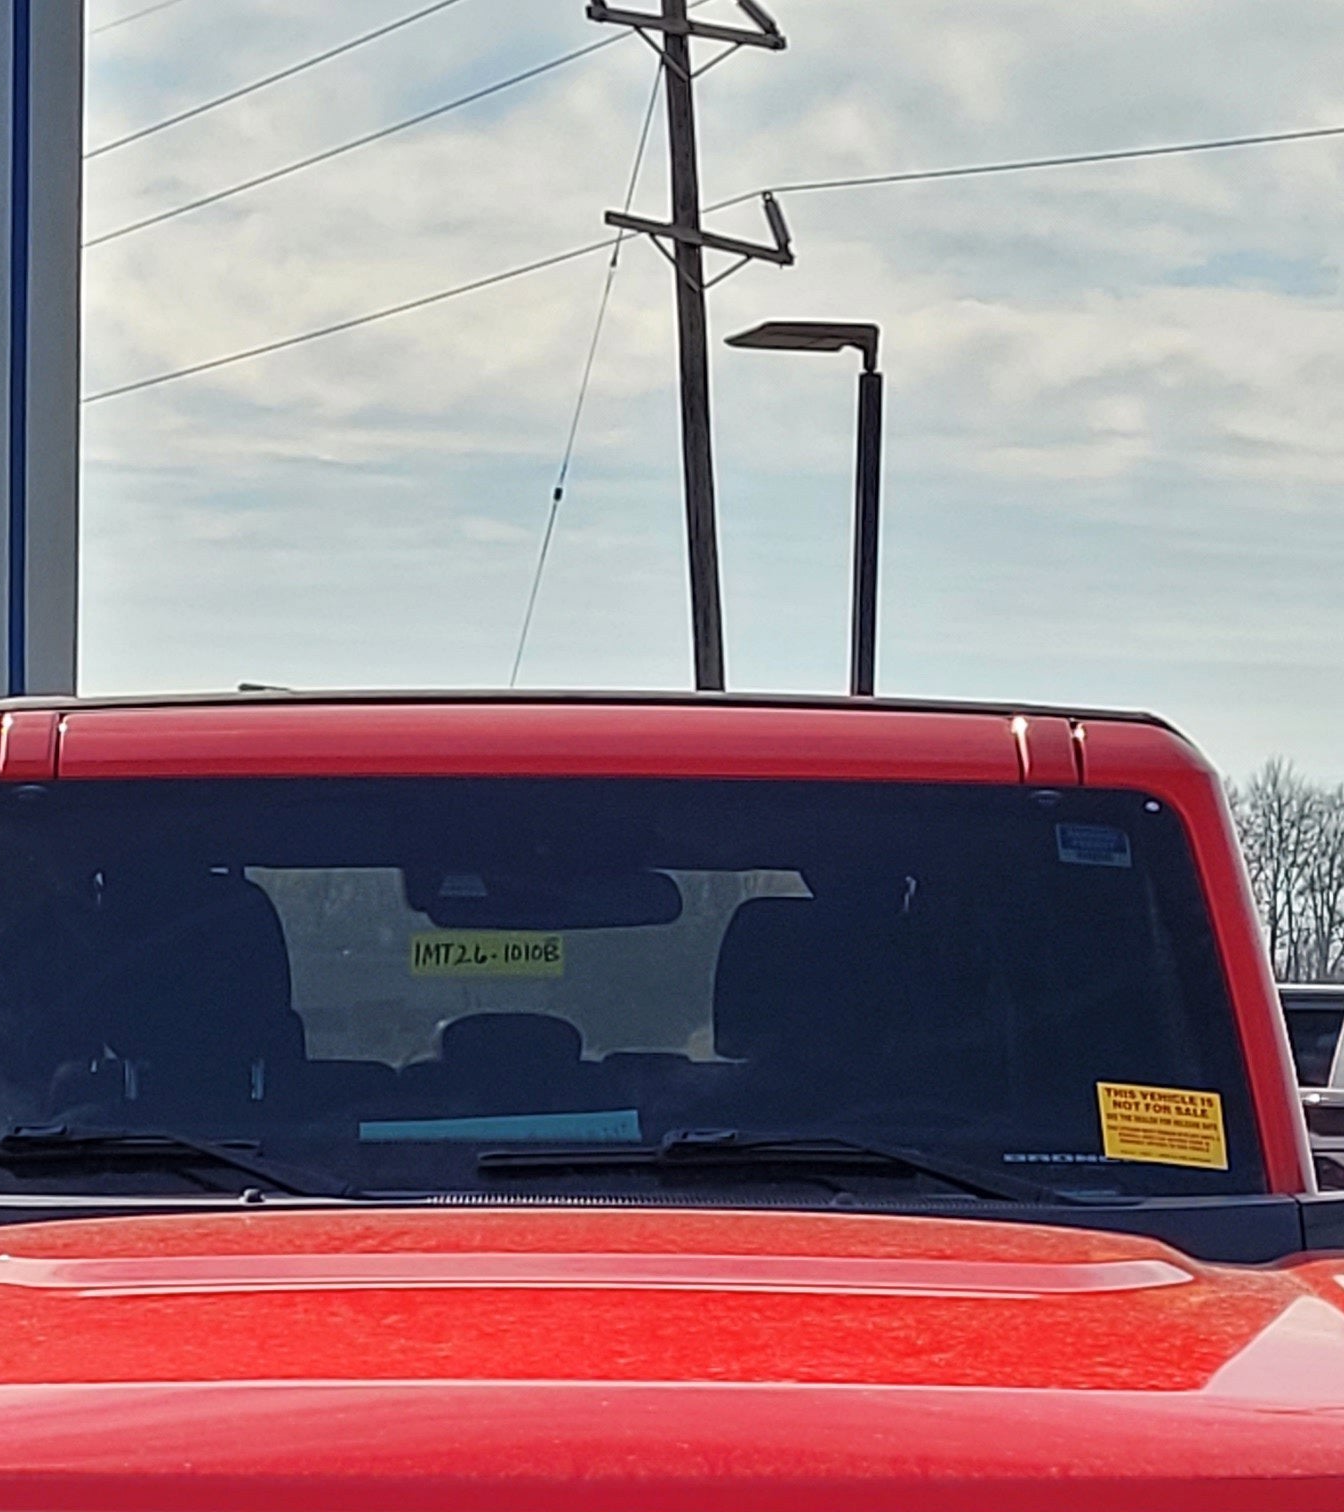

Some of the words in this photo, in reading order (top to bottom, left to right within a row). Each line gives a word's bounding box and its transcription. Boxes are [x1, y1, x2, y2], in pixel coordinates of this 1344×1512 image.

[1105, 1087, 1137, 1100] THIS
[1139, 1091, 1199, 1108] VEHICLE
[1201, 1097, 1214, 1108] IS
[1112, 1100, 1141, 1112] NOT
[1145, 1103, 1172, 1115] FOR
[1175, 1106, 1209, 1119] SALE
